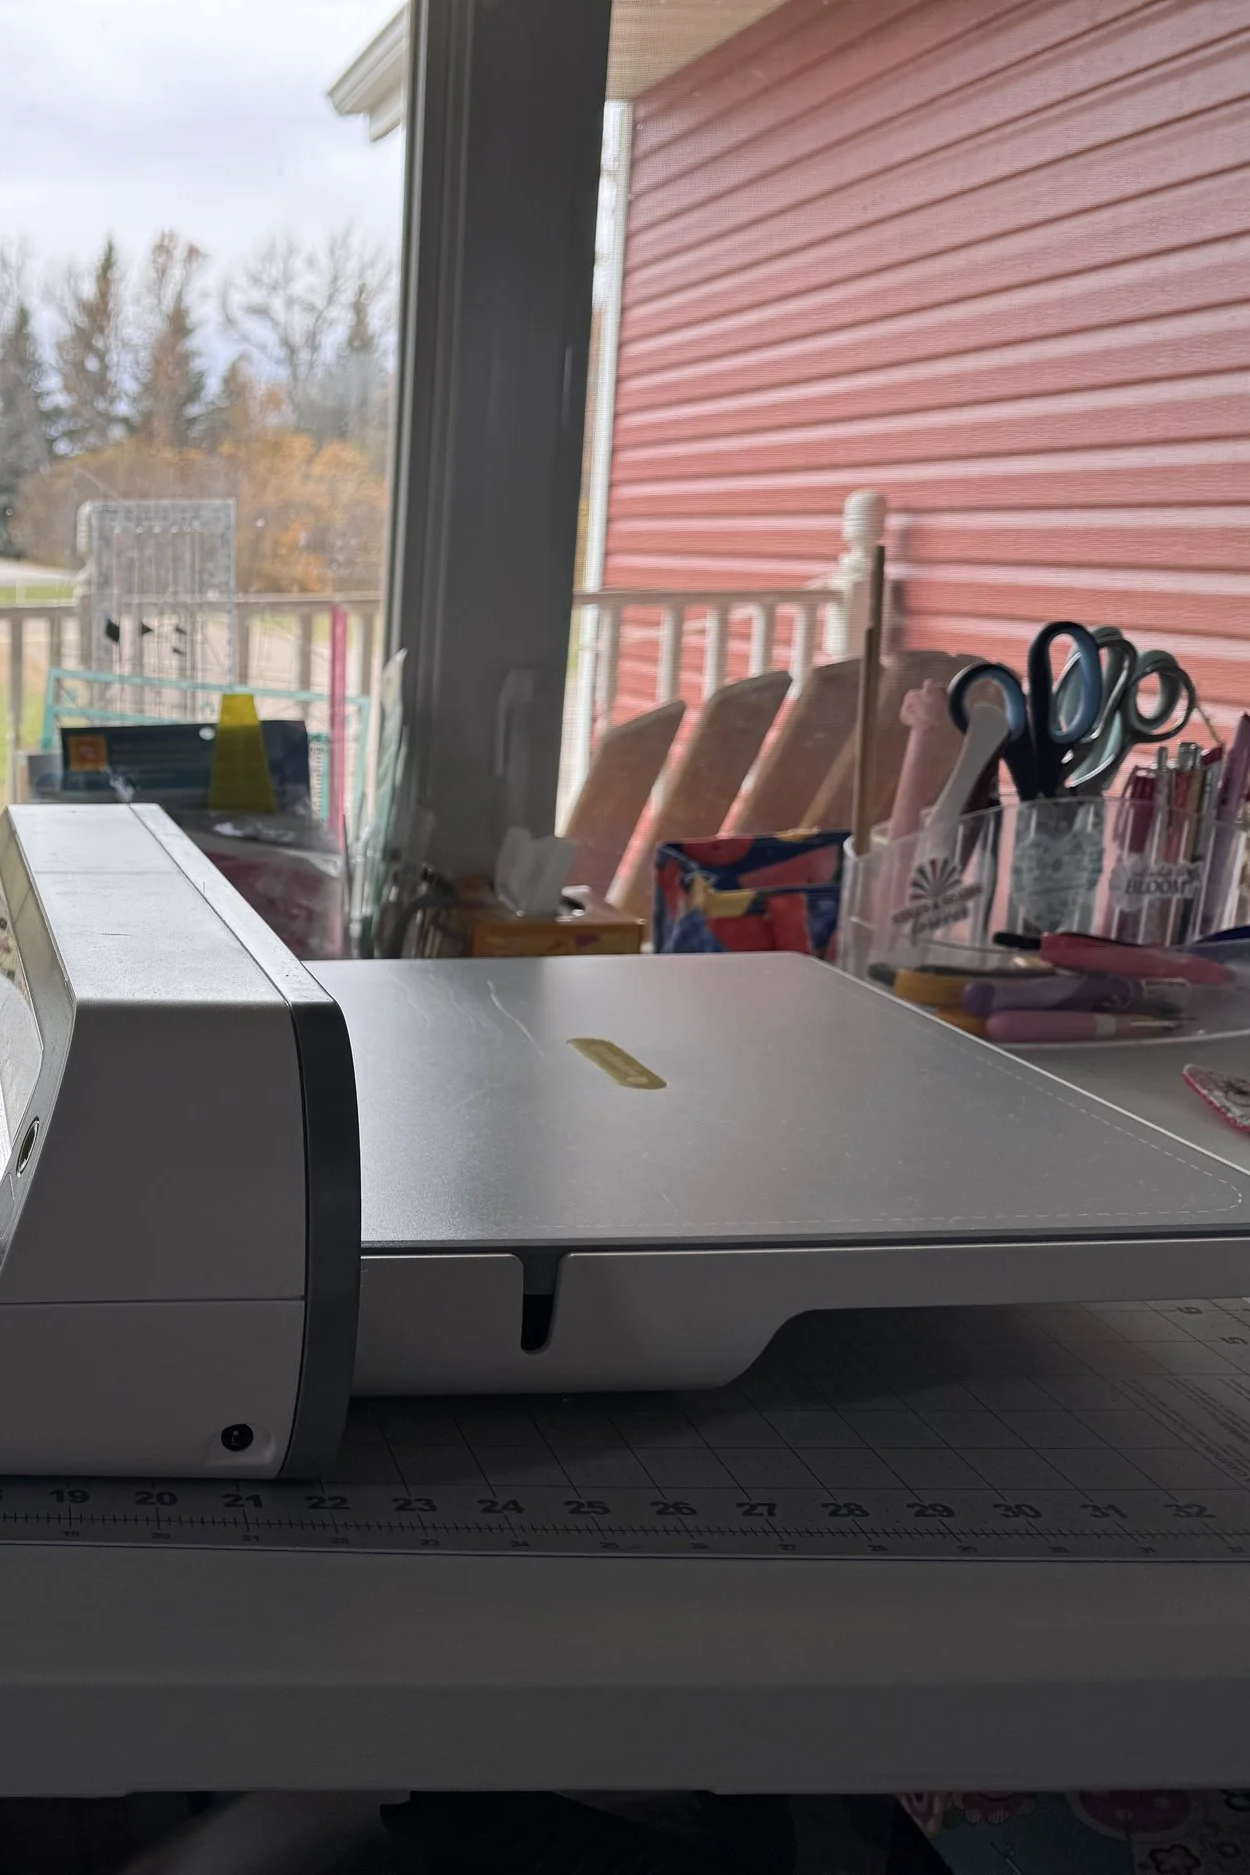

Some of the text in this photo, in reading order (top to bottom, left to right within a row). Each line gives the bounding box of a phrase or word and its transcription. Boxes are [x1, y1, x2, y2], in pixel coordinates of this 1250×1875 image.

[1177, 1306, 1203, 1314] 6
[1219, 1336, 1248, 1345] 5
[49, 1489, 90, 1503] 19
[134, 1491, 178, 1505] 20
[222, 1493, 262, 1507] 21
[305, 1496, 351, 1510] 22
[391, 1497, 437, 1512] 23
[478, 1499, 525, 1513] 24
[564, 1500, 610, 1515] 25
[650, 1501, 697, 1515] 26
[736, 1502, 776, 1517] 27
[821, 1503, 870, 1517] 28
[906, 1503, 955, 1517] 29
[992, 1504, 1043, 1518] 30
[1080, 1504, 1128, 1518] 31
[1163, 1503, 1216, 1518] 32
